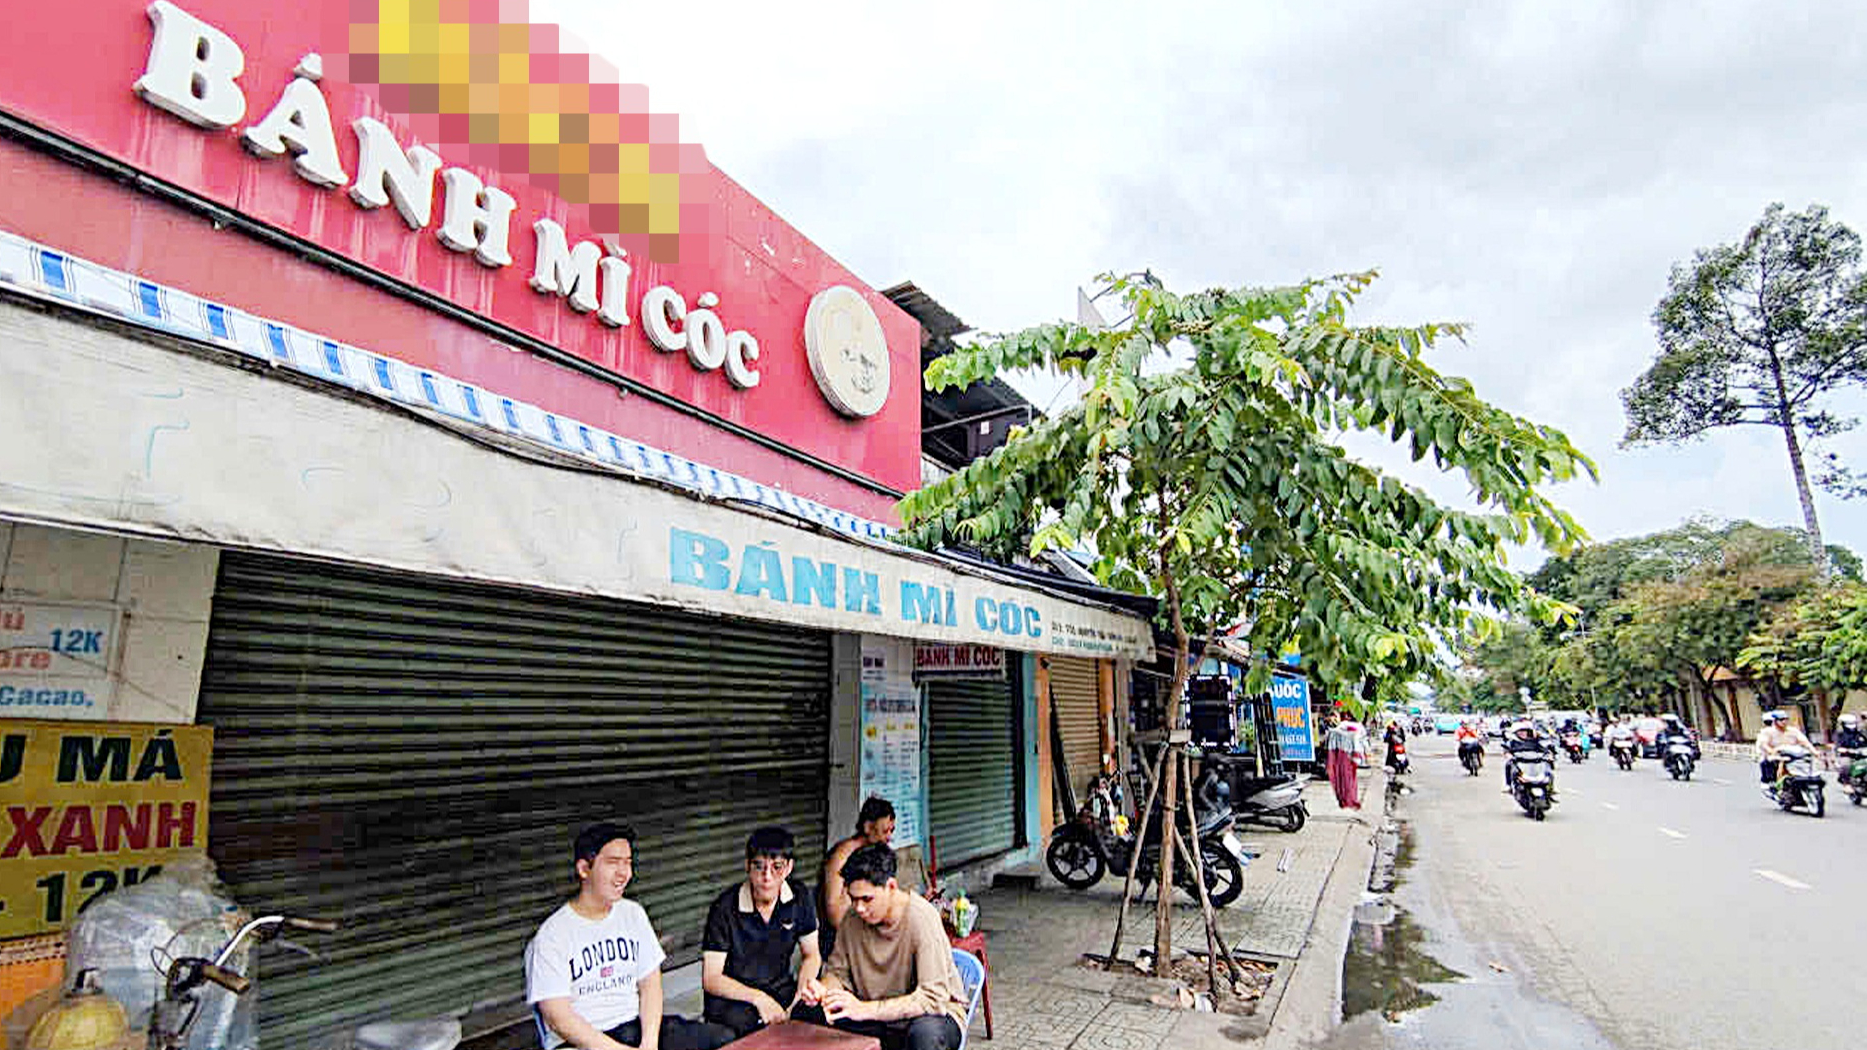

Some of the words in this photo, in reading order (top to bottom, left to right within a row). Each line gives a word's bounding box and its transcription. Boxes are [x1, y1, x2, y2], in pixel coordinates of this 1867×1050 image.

[133, 0, 517, 268] BÁNH
[529, 218, 632, 328] MÌ
[641, 285, 761, 389] CÓC
[669, 527, 882, 615] BÁNH
[50, 628, 103, 653] 12K
[56, 729, 183, 783] MÁ
[0, 801, 197, 859] XANH
[568, 937, 640, 981] LONDON
[578, 974, 633, 996] ENGLAND
